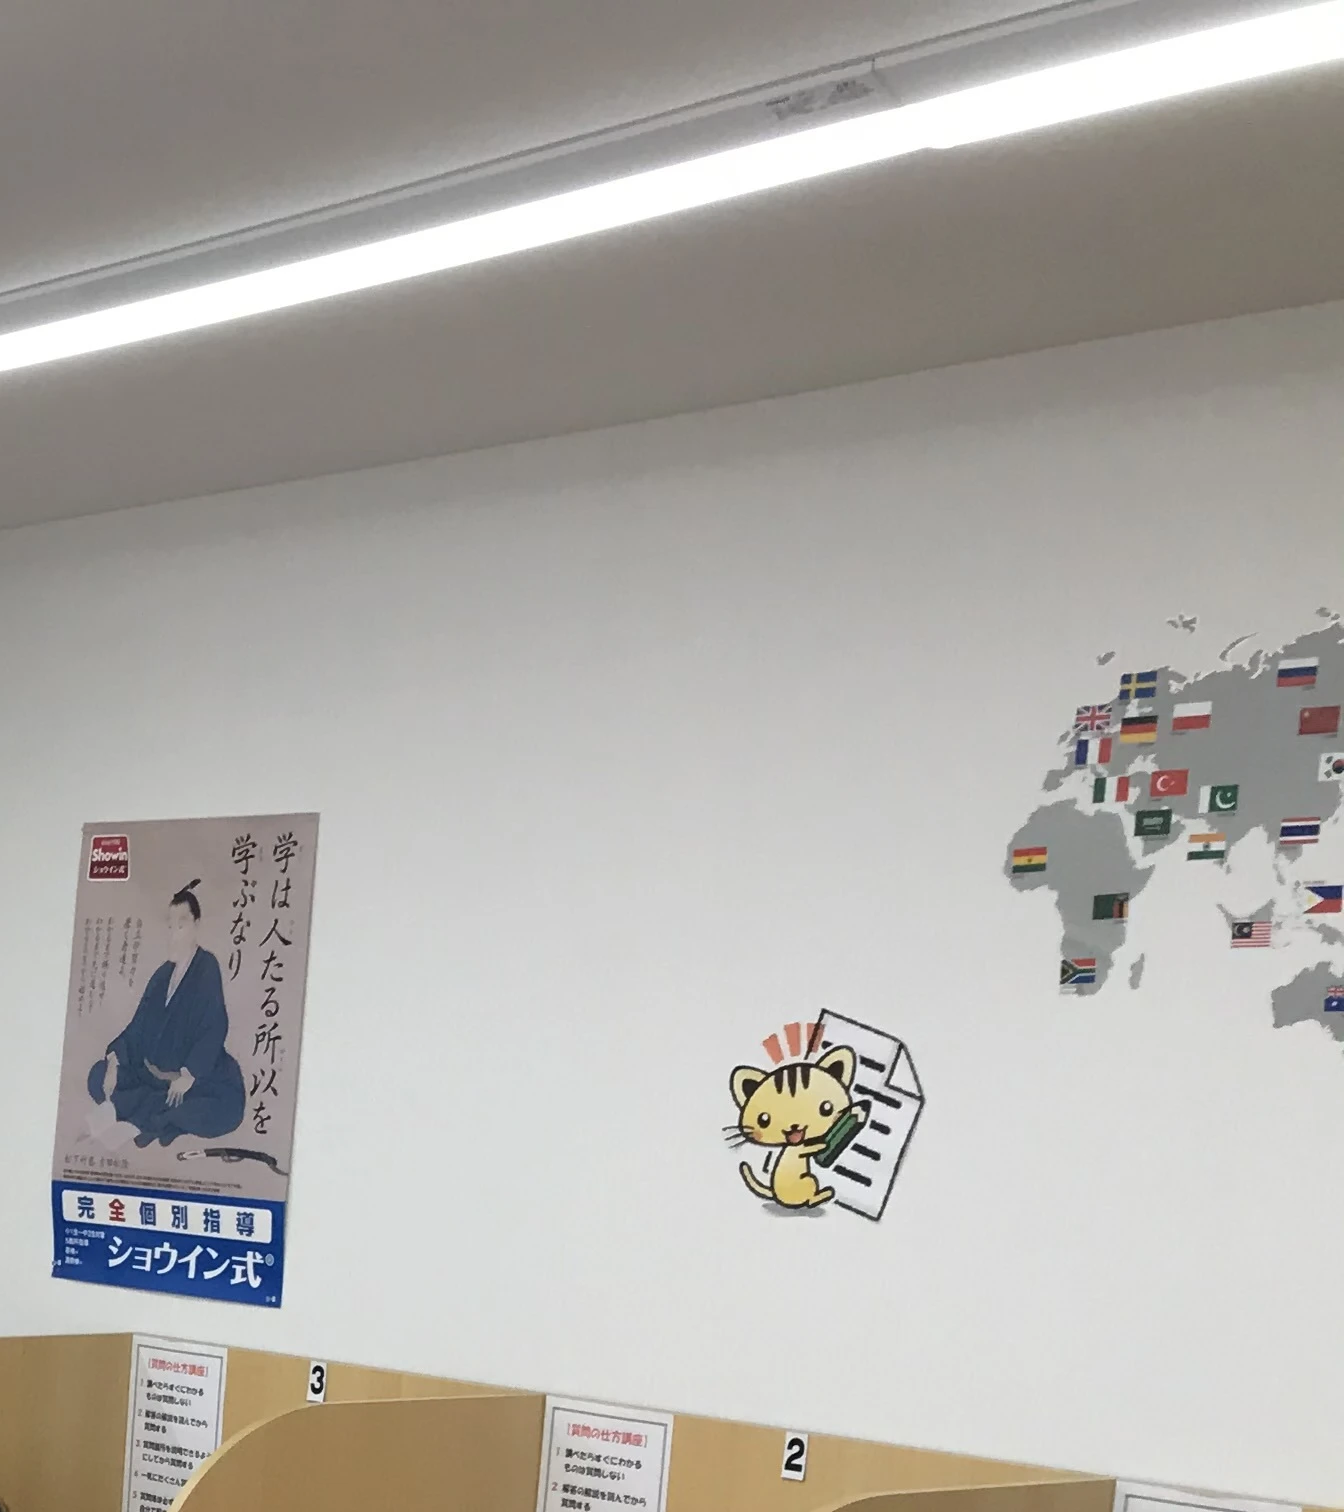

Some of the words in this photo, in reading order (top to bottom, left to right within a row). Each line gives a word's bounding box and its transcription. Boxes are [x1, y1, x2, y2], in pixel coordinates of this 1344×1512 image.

[90, 847, 128, 862] Showin
[227, 832, 258, 982] 学ぶなり
[249, 831, 298, 1135] 学は人たる所以を
[76, 1195, 256, 1238] 完全個別指導
[107, 1235, 265, 1288] ショウイン式
[309, 1365, 325, 1395] 3
[783, 1437, 806, 1473] 2
